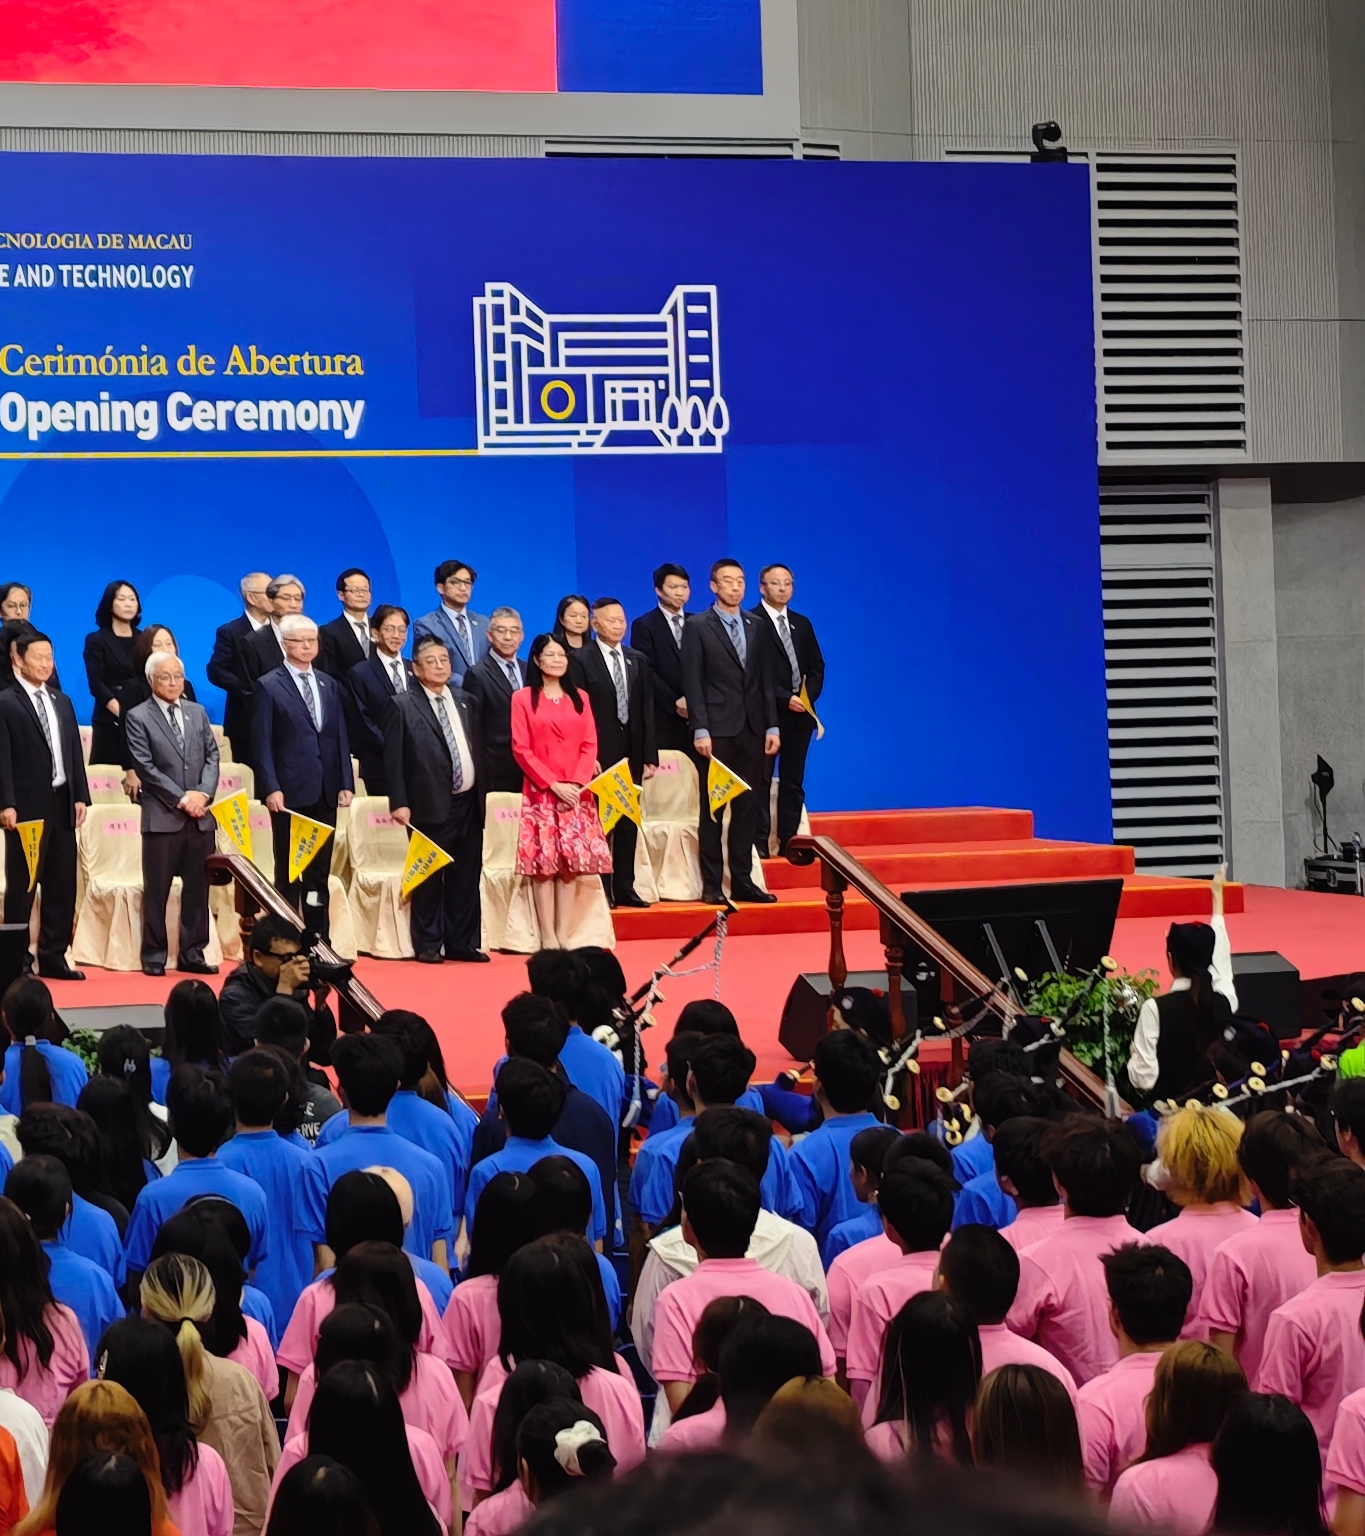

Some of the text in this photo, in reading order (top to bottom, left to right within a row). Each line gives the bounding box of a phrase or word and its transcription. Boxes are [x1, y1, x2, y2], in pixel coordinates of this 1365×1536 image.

[97, 233, 124, 250] DE
[128, 233, 192, 250] MACAU
[13, 264, 55, 289] AND
[58, 264, 194, 290] TECHNOLOGY
[176, 344, 216, 377] de
[223, 344, 365, 377] Abertura
[166, 390, 366, 440] Ceremony
